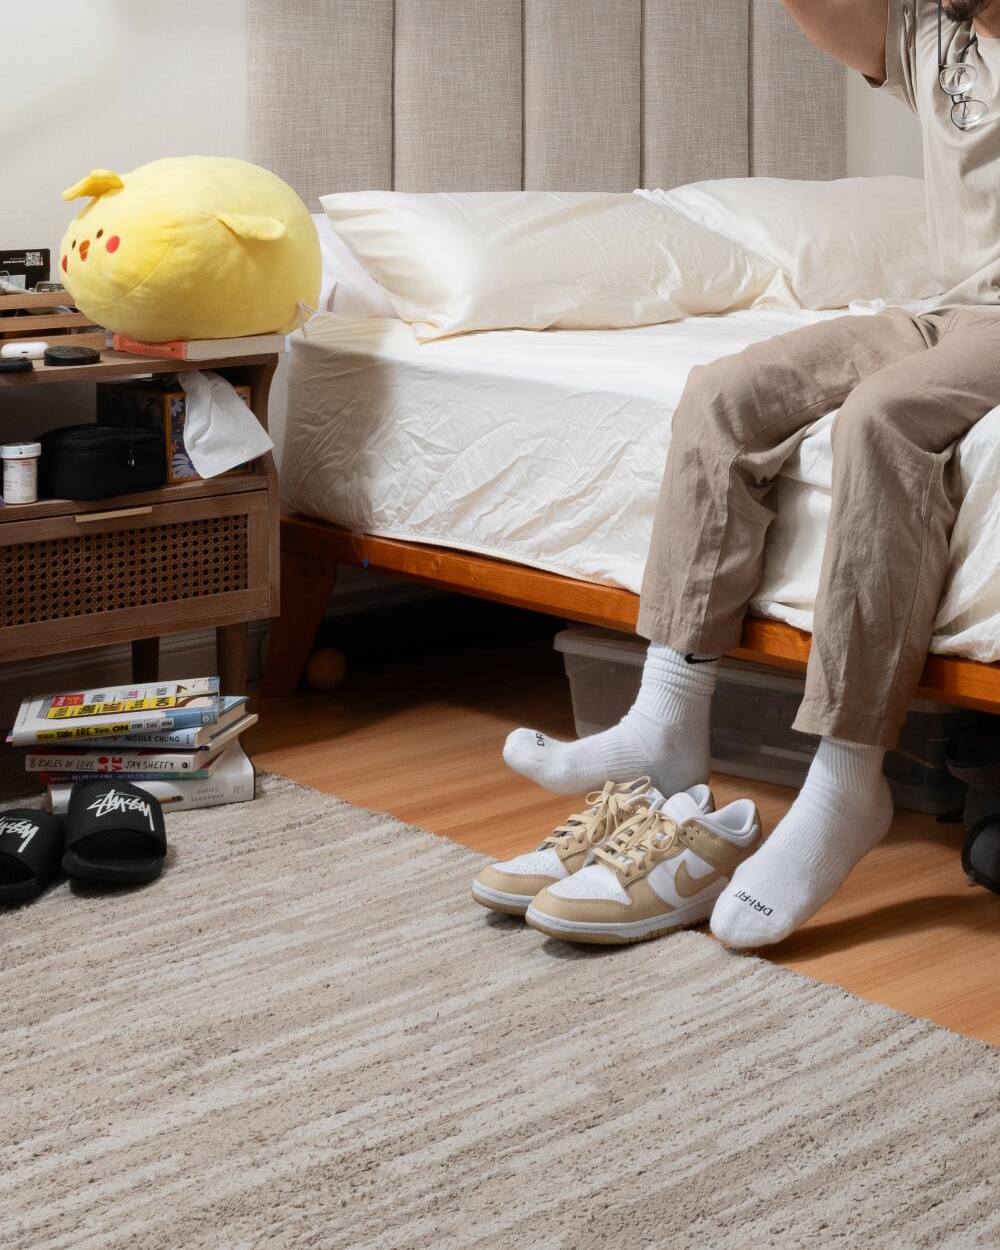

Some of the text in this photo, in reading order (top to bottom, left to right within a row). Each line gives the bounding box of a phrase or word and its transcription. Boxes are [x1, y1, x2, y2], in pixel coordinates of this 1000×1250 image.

[112, 724, 129, 733] ON
[125, 734, 152, 742] NICOLE
[155, 734, 180, 743] CHUNG
[30, 758, 96, 768] 8 RULES OF LOVE
[125, 760, 174, 769] JAY SHETTY
[733, 890, 774, 916] DRI-FIT
